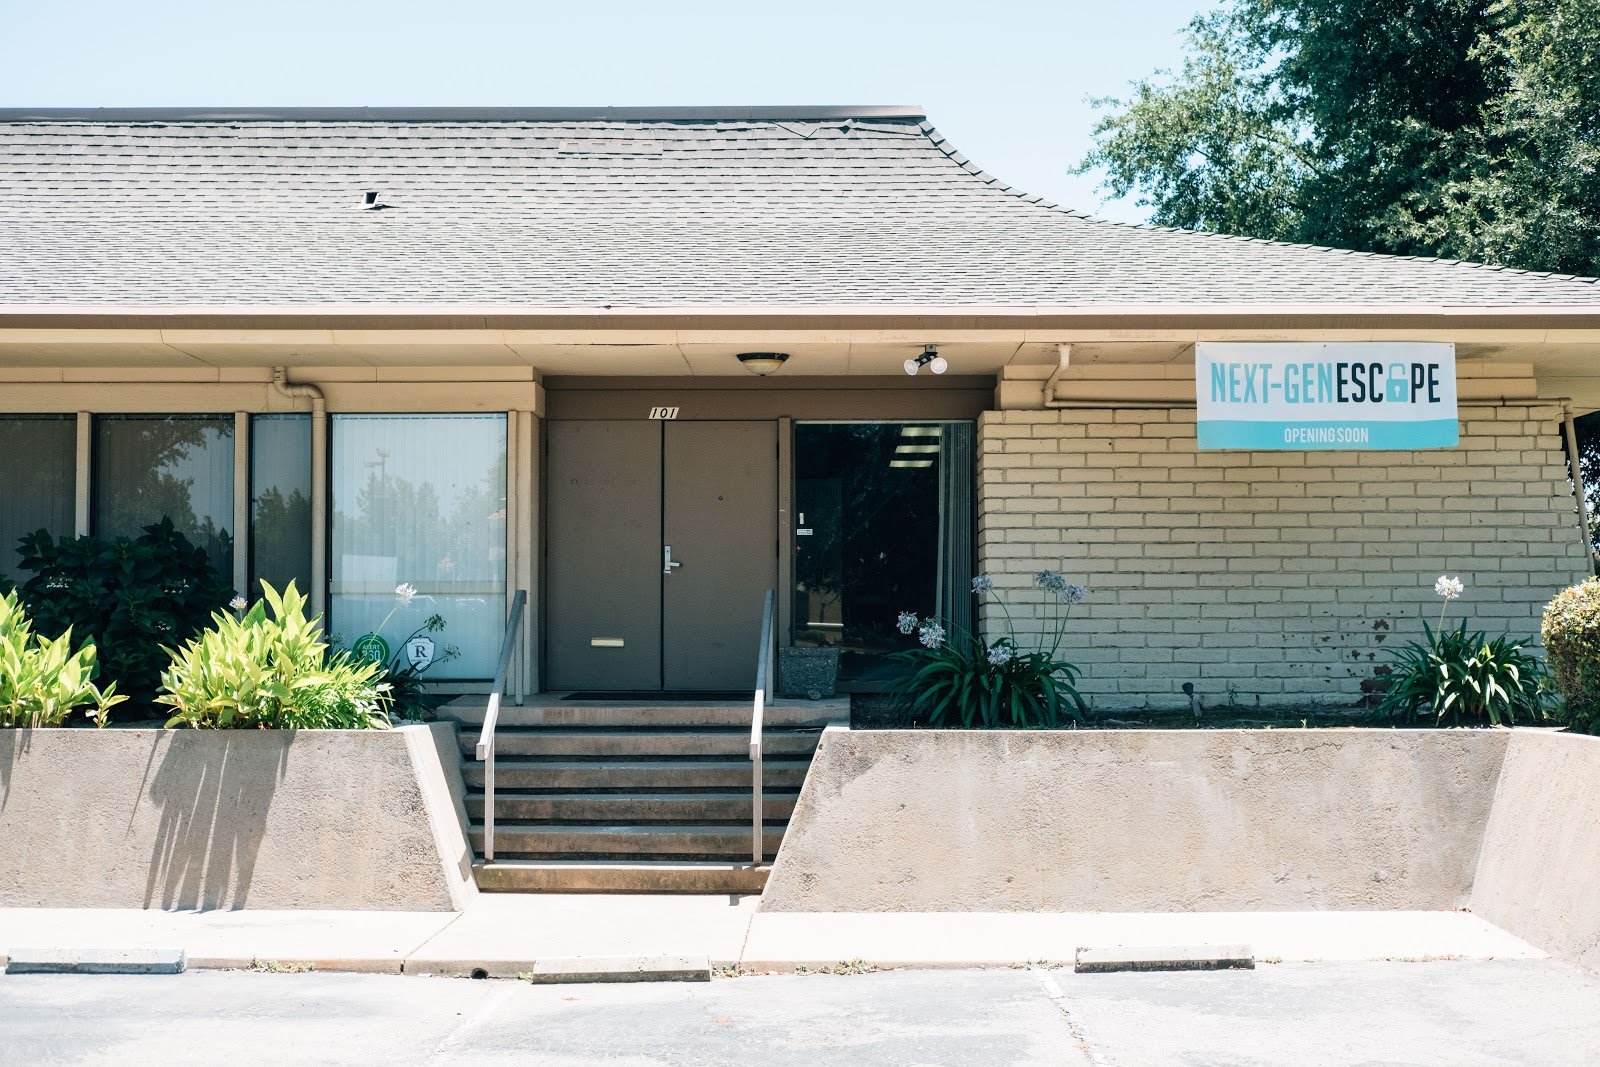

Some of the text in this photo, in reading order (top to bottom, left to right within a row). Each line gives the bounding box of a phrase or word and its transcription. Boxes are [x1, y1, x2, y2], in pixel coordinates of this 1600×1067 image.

[652, 407, 676, 419] 101
[1284, 427, 1369, 443] OPENING SOON
[414, 645, 428, 658] R
